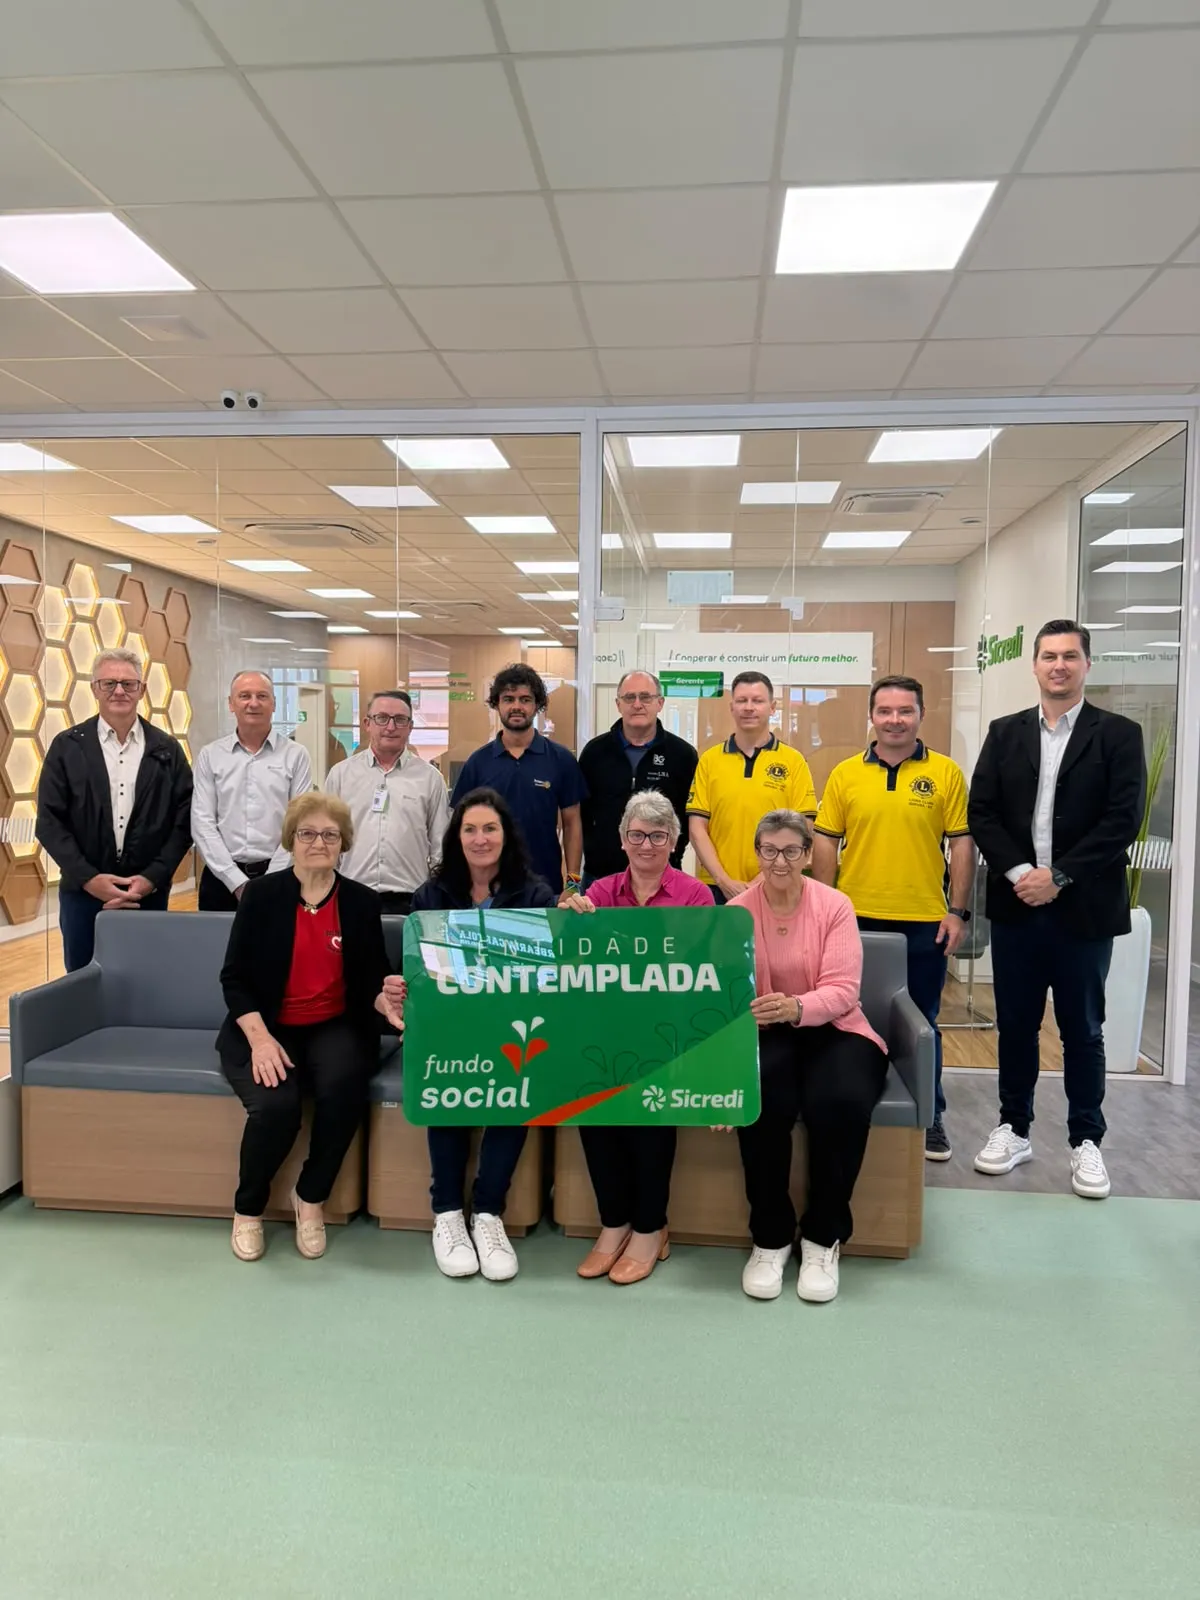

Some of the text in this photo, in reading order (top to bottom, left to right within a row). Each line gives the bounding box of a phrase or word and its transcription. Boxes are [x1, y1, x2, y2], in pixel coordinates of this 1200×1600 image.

[675, 653, 717, 663] Cooperar
[720, 653, 725, 662] é
[727, 653, 769, 662] construir
[788, 654, 820, 664] futuro
[822, 654, 858, 663] melhor.
[988, 625, 1023, 666] Sicredi
[478, 937, 676, 957] ENTIDADE
[436, 963, 721, 995] CONTEMPLADA
[423, 1053, 494, 1079] fundo
[421, 1077, 530, 1109] social
[670, 1088, 744, 1108] Sicredi
